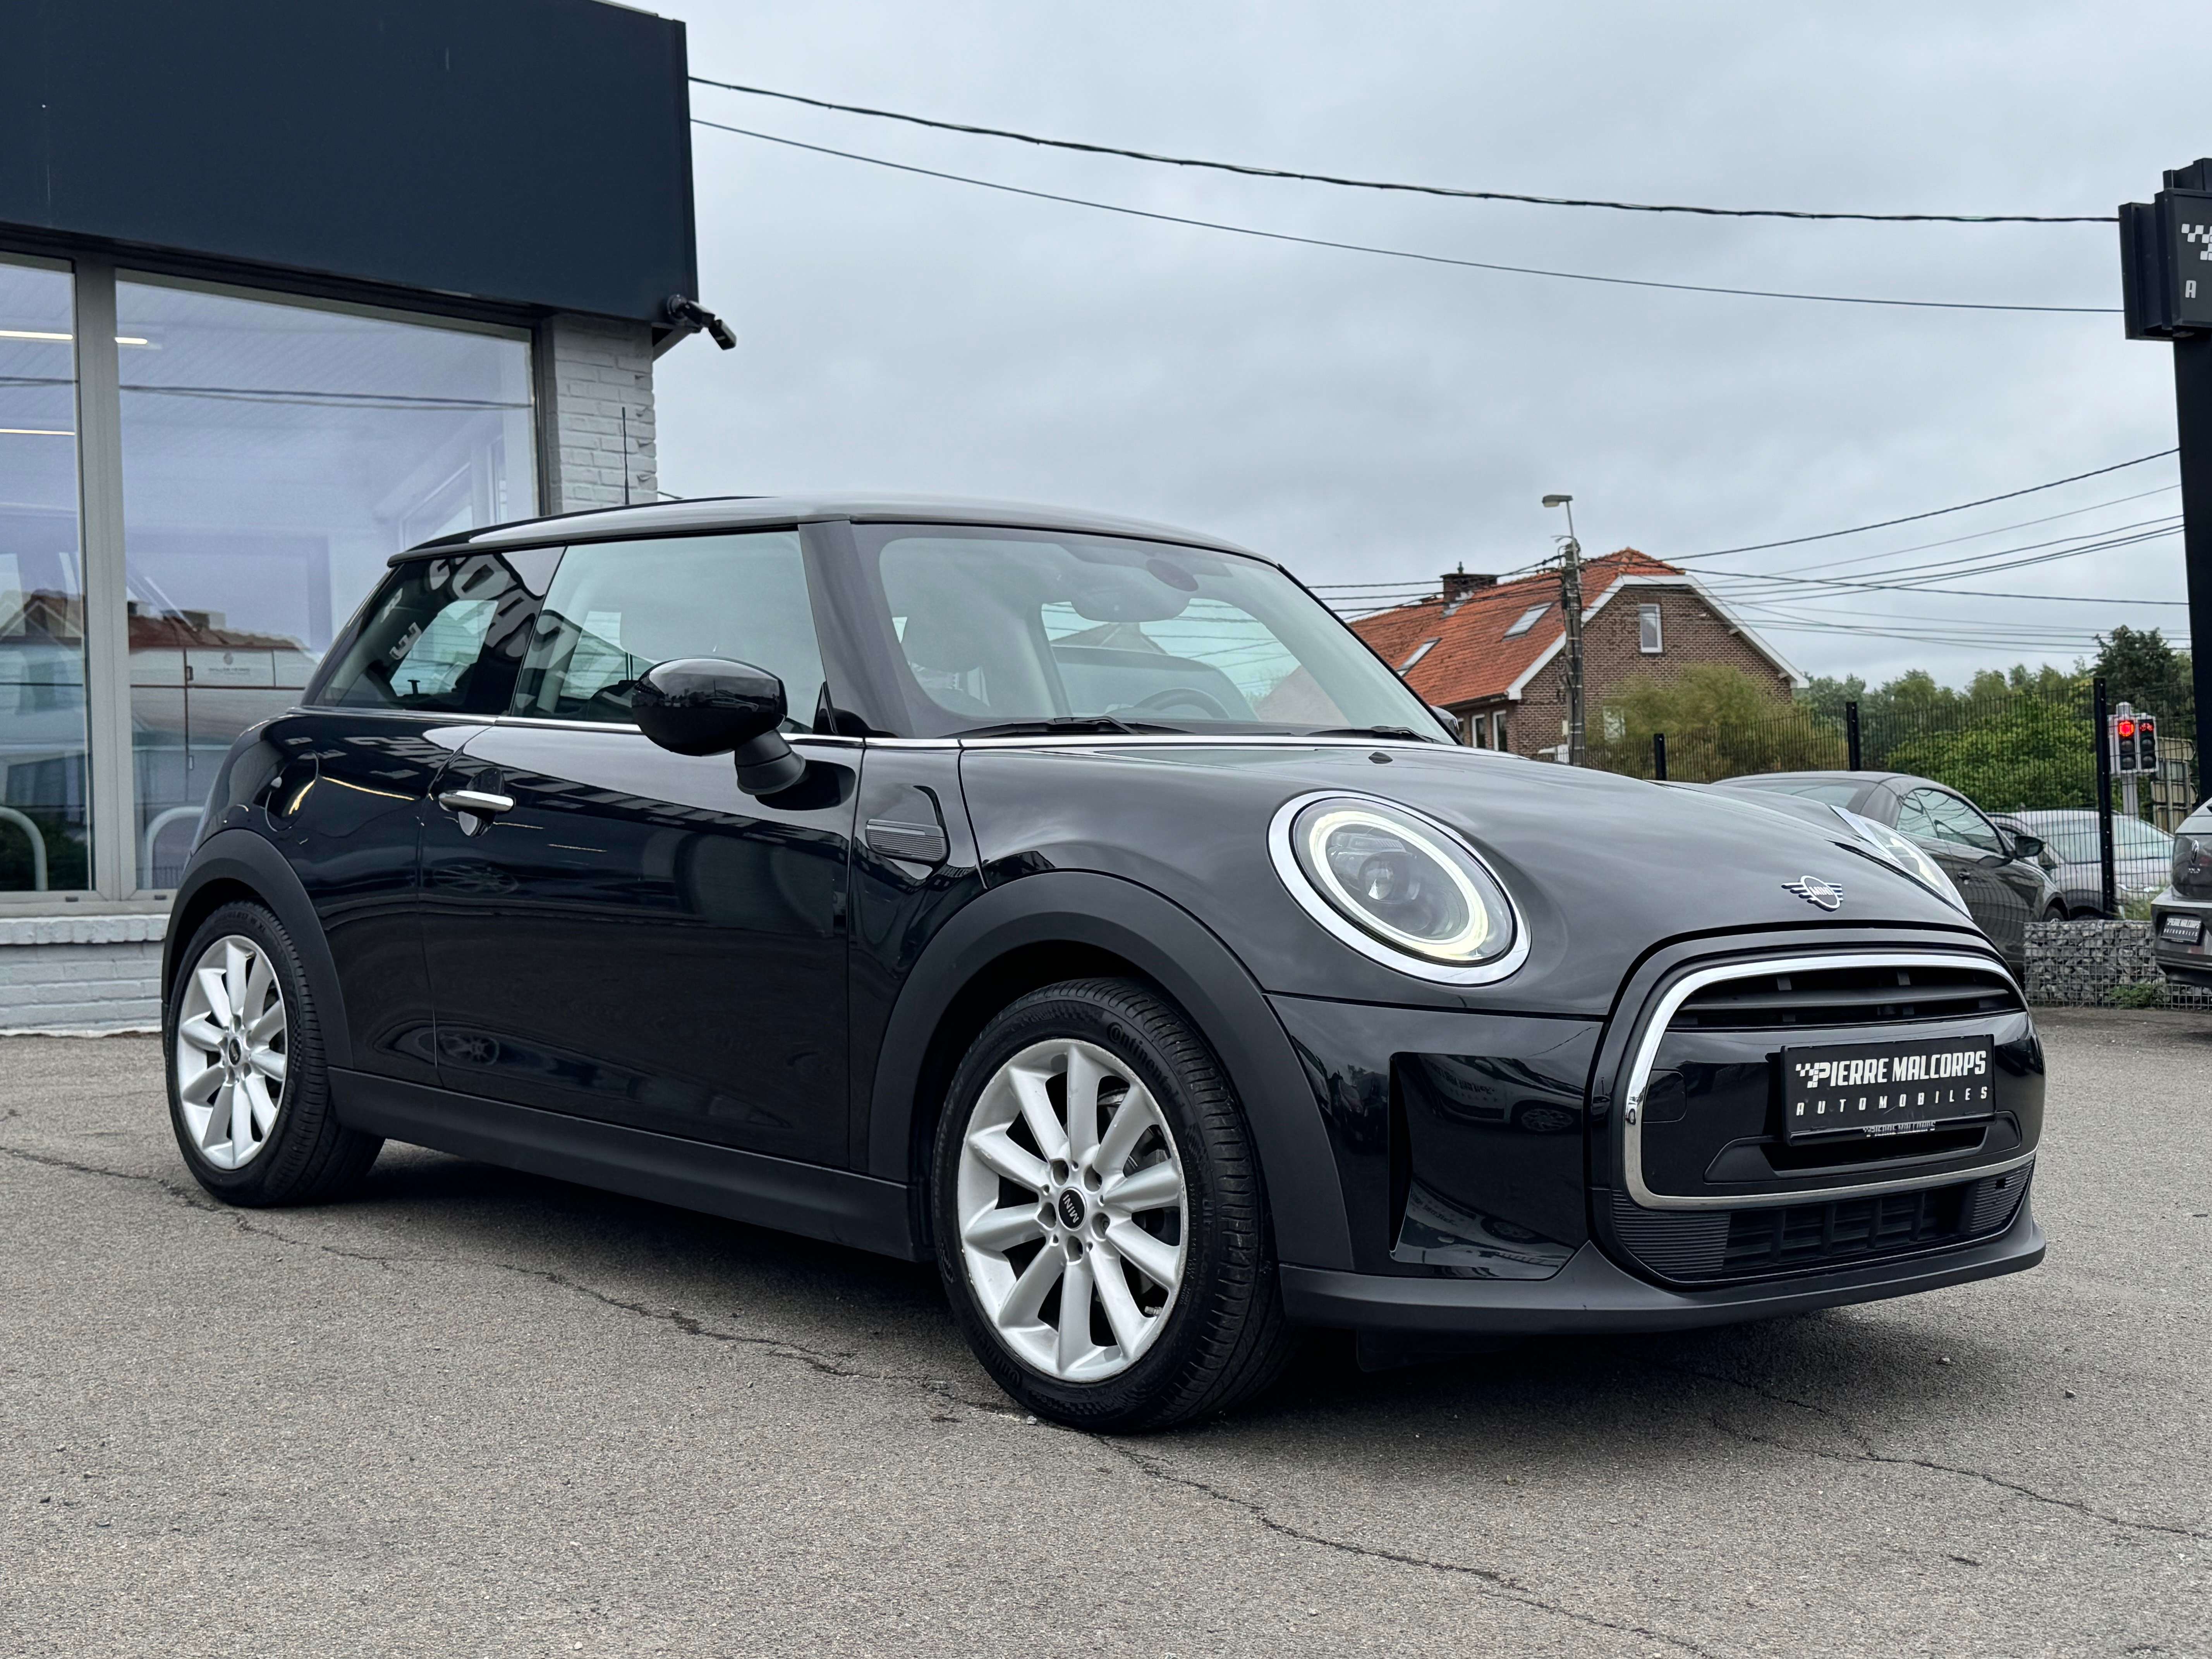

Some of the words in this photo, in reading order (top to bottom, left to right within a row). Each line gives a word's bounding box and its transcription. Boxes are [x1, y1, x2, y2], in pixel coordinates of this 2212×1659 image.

[1805, 1058, 1889, 1089] PIERRE
[1892, 1050, 1986, 1082] MALCORPS
[1796, 1086, 1987, 1116] AUTOMOBILES
[1063, 1194, 1079, 1223] MINI
